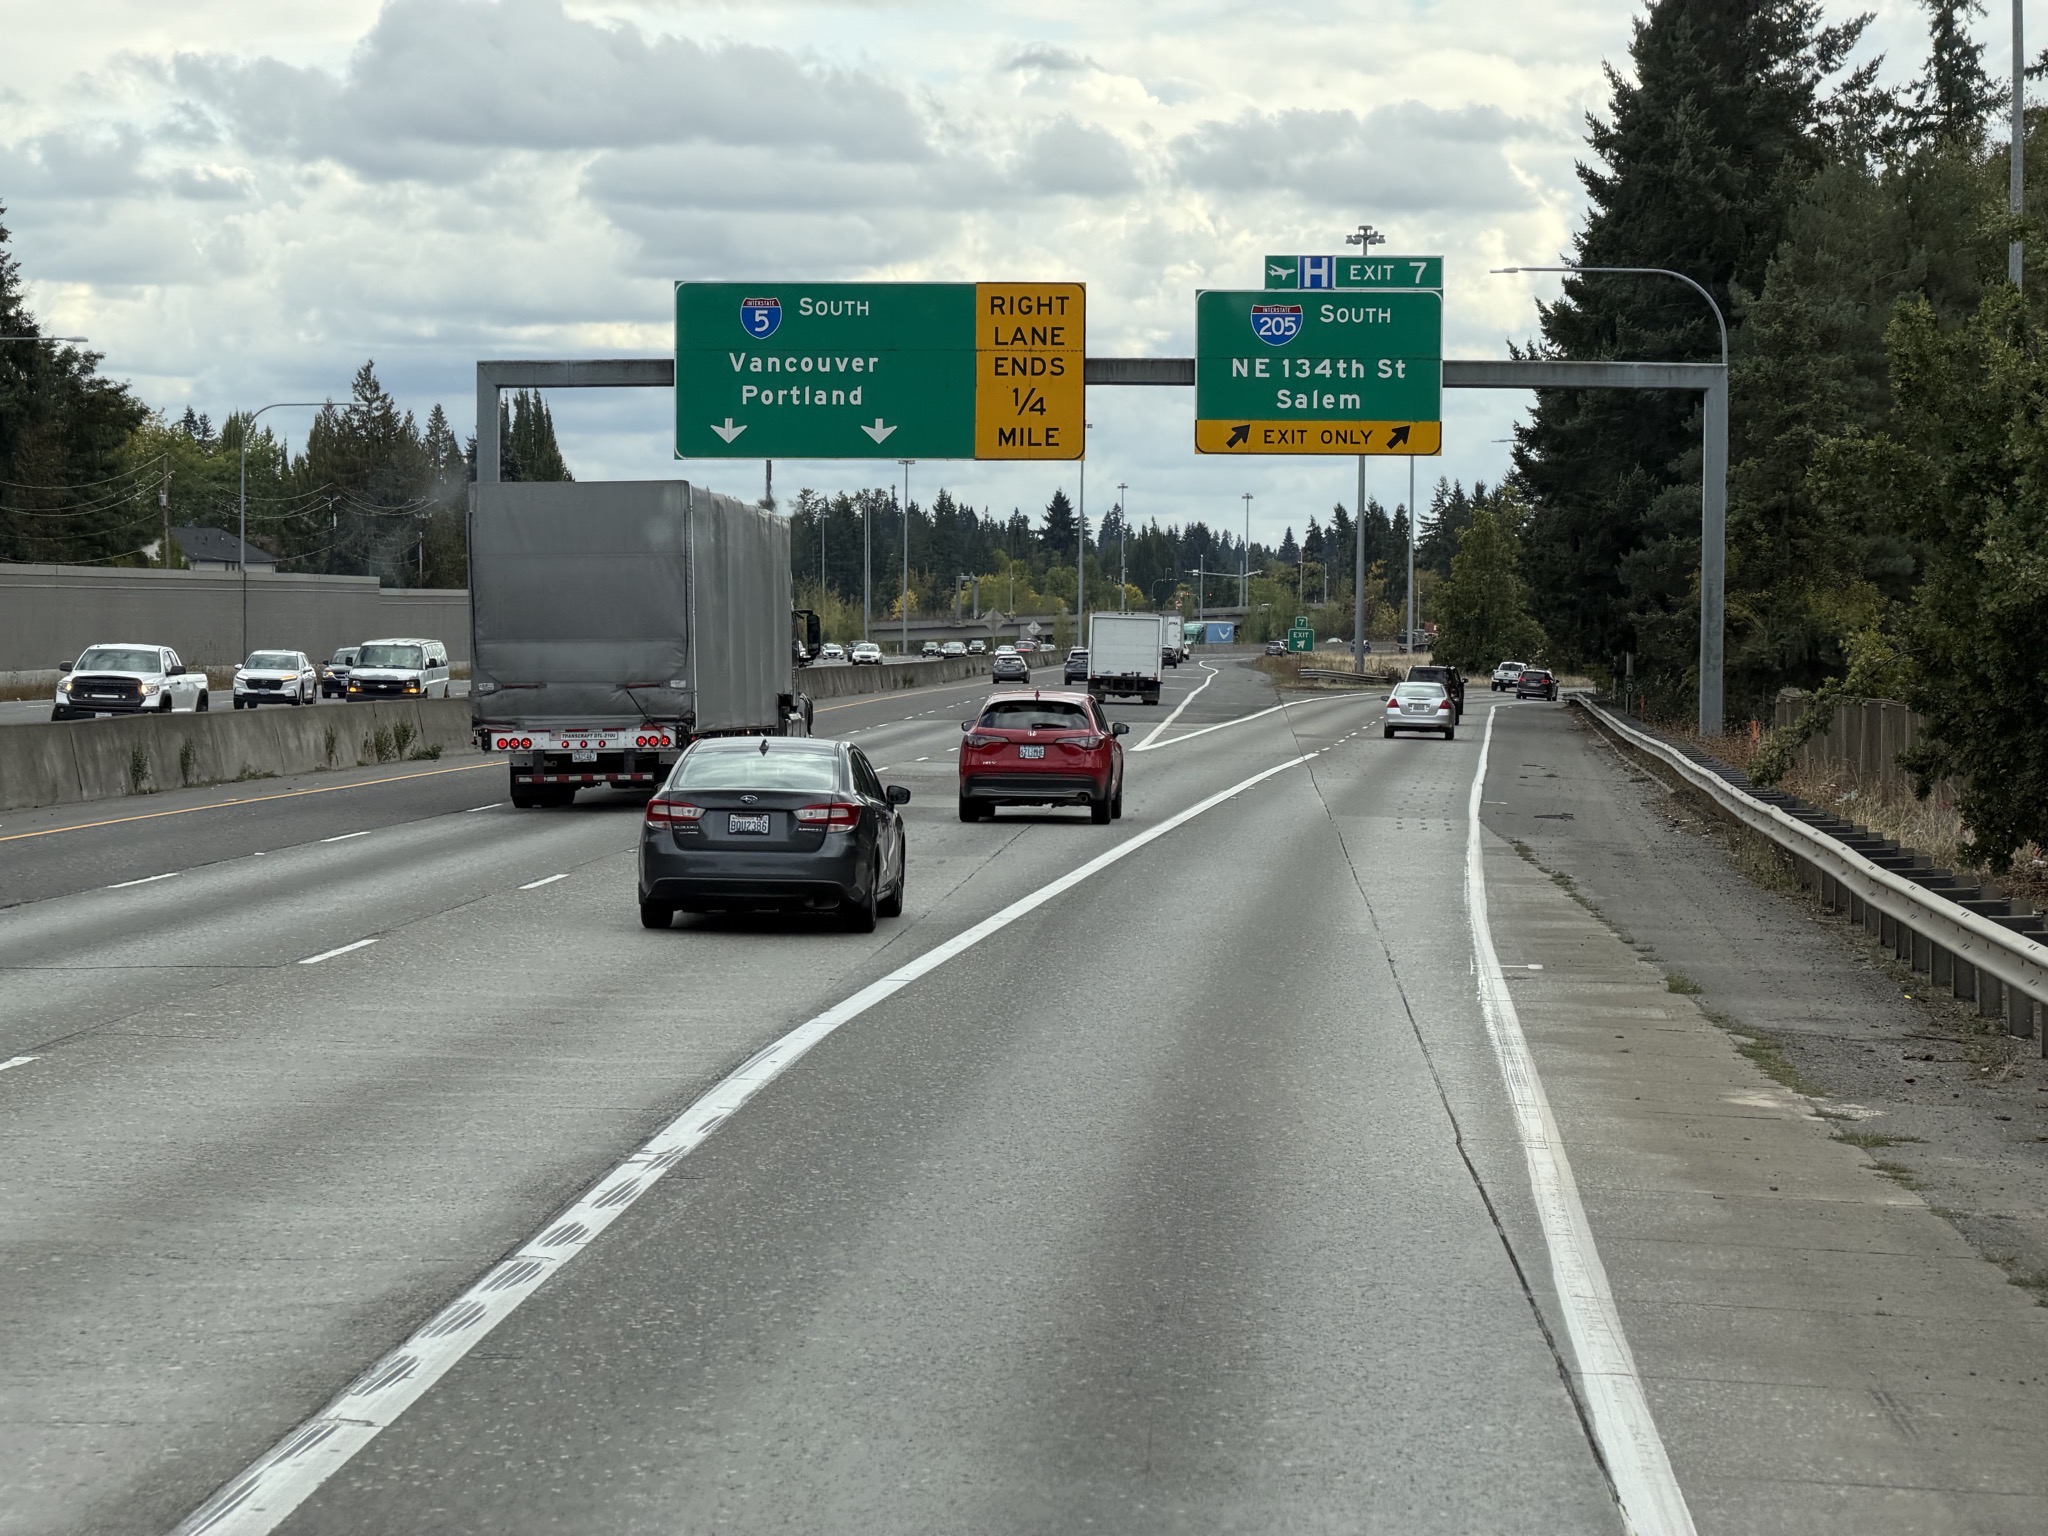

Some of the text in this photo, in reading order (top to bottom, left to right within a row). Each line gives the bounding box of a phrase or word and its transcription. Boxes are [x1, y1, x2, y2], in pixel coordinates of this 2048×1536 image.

[1303, 257, 1329, 288] H
[1350, 261, 1428, 284] EXIT 7
[989, 295, 1070, 316] RIGHT
[754, 309, 770, 332] 5
[1259, 316, 1297, 336] 205
[994, 326, 1065, 346] LANE
[729, 352, 879, 373] Vancouver
[994, 356, 1065, 377] ENDS
[1232, 358, 1406, 379] NE 134th St
[741, 385, 863, 406] Portland
[1276, 389, 1361, 410] Salem
[997, 427, 1060, 447] MILE
[1263, 429, 1374, 445] EXIT ONLY
[1298, 618, 1305, 626] 7
[1293, 631, 1310, 639] EXIT
